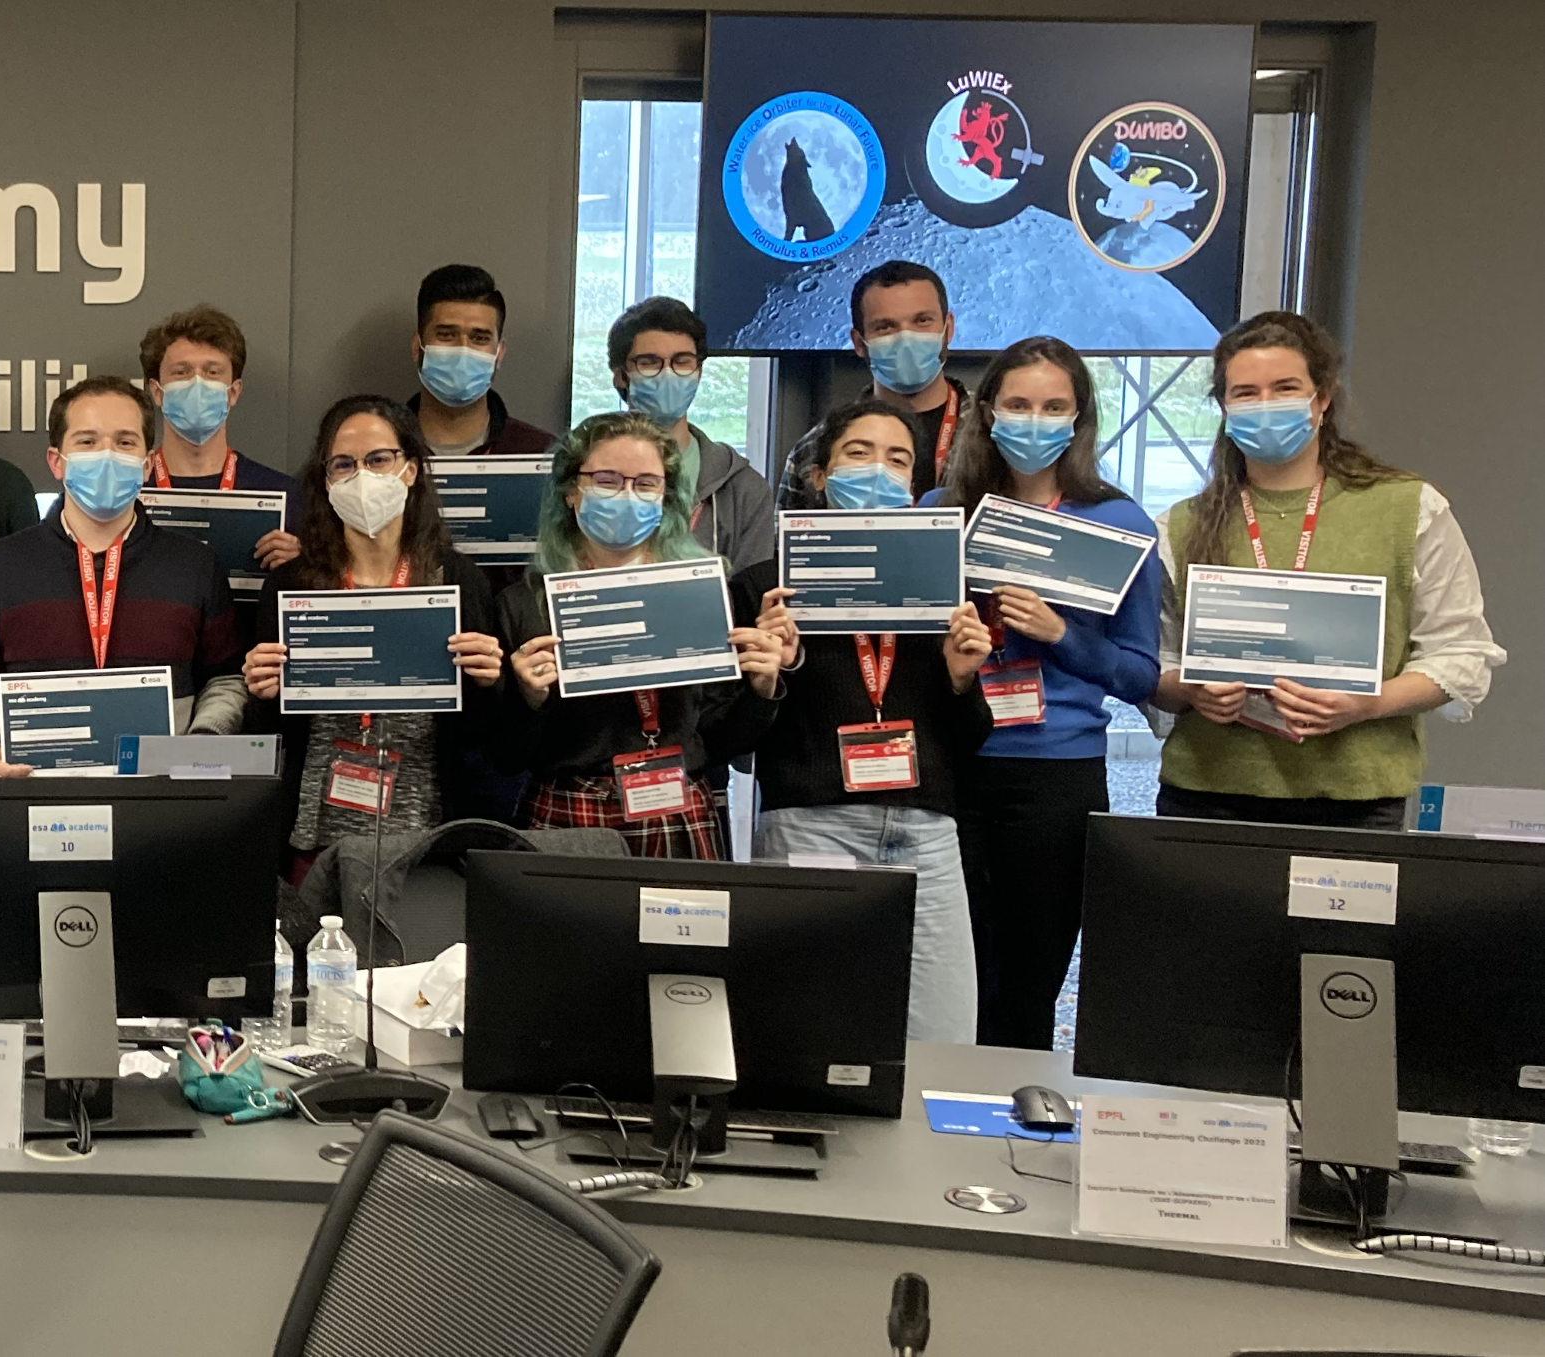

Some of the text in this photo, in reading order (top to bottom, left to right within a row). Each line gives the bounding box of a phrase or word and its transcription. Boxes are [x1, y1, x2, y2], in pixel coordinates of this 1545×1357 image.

[946, 70, 1012, 95] LuWIEx
[727, 118, 763, 173] Water-ice
[762, 98, 803, 120] Orbiter
[834, 103, 862, 134] Lunar
[859, 130, 879, 171] Future
[1113, 119, 1187, 141] DUMBO
[751, 228, 849, 259] Romulus & Remus
[790, 519, 816, 528] EPFL
[1295, 530, 1312, 569] VISITOR
[82, 547, 92, 582] VISITOR
[107, 545, 118, 580] VISITOR
[1199, 572, 1226, 582] EPFL
[556, 581, 582, 591] EPFL
[102, 590, 113, 626] VISITOR
[289, 600, 314, 608] EPFL
[862, 655, 877, 692] VISITOR
[7, 682, 32, 691] EPFL
[121, 751, 134, 759] 10
[1420, 803, 1435, 813] 12
[32, 822, 108, 833] esa academy
[61, 841, 75, 852] 10
[1294, 876, 1392, 893] esa academy
[1328, 898, 1346, 911] 12
[645, 906, 726, 919] esa academy
[59, 921, 94, 932] DELL
[676, 925, 691, 936] 11
[670, 989, 707, 998] DELL
[1327, 988, 1370, 1002] DELL
[1097, 1110, 1126, 1121] EPFL
[1092, 1128, 1266, 1147] Concurrent Engineering Challenge 2022
